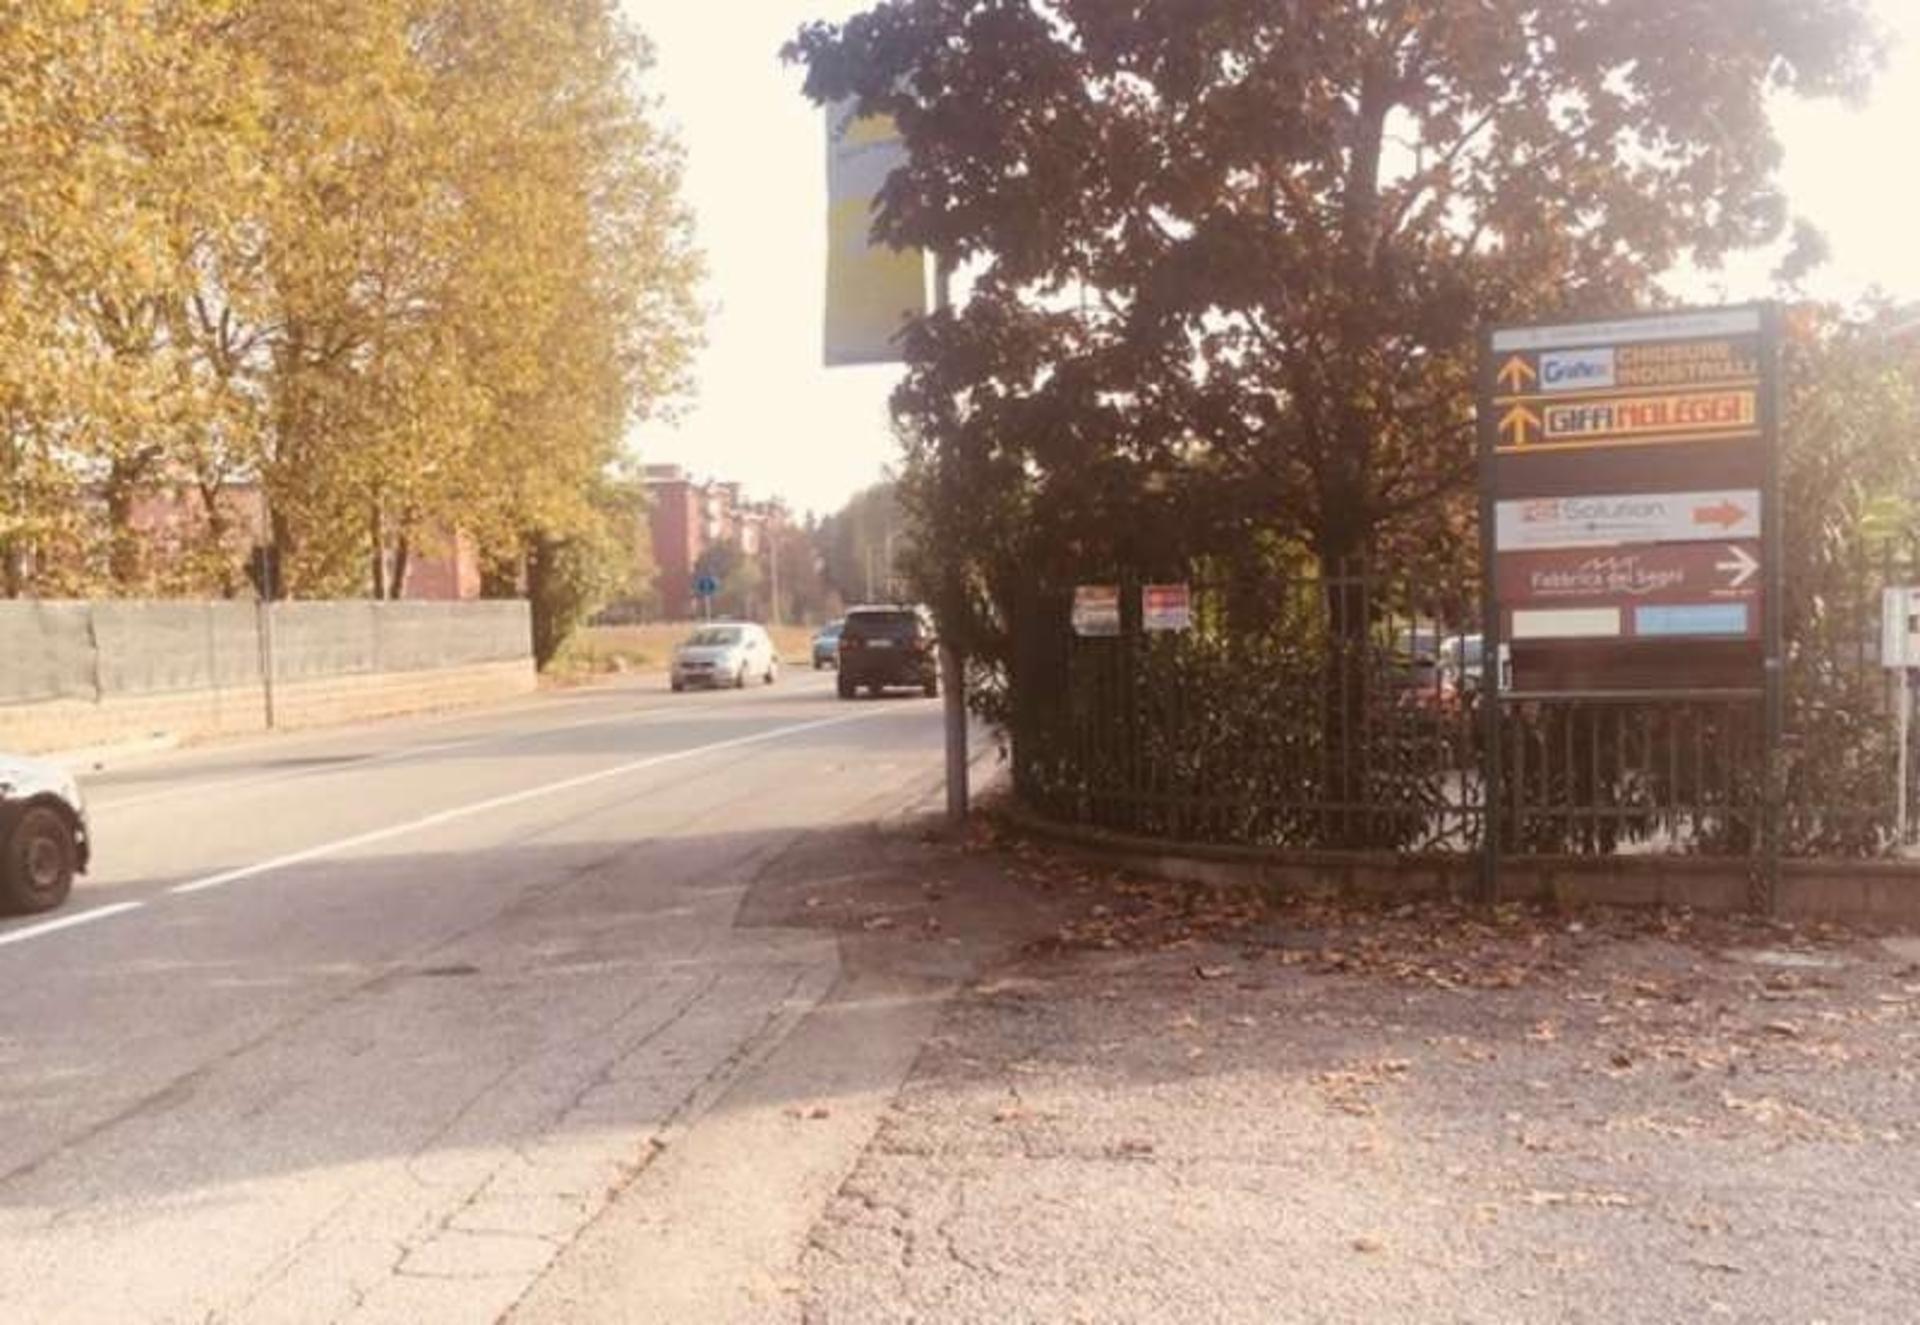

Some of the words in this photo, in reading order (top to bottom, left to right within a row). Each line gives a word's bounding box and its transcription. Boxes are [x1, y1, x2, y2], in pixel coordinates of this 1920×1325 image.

[1550, 406, 1613, 434] GIFFI
[1616, 395, 1741, 428] NOLEGGI
[1531, 571, 1602, 589] Fabbrica
